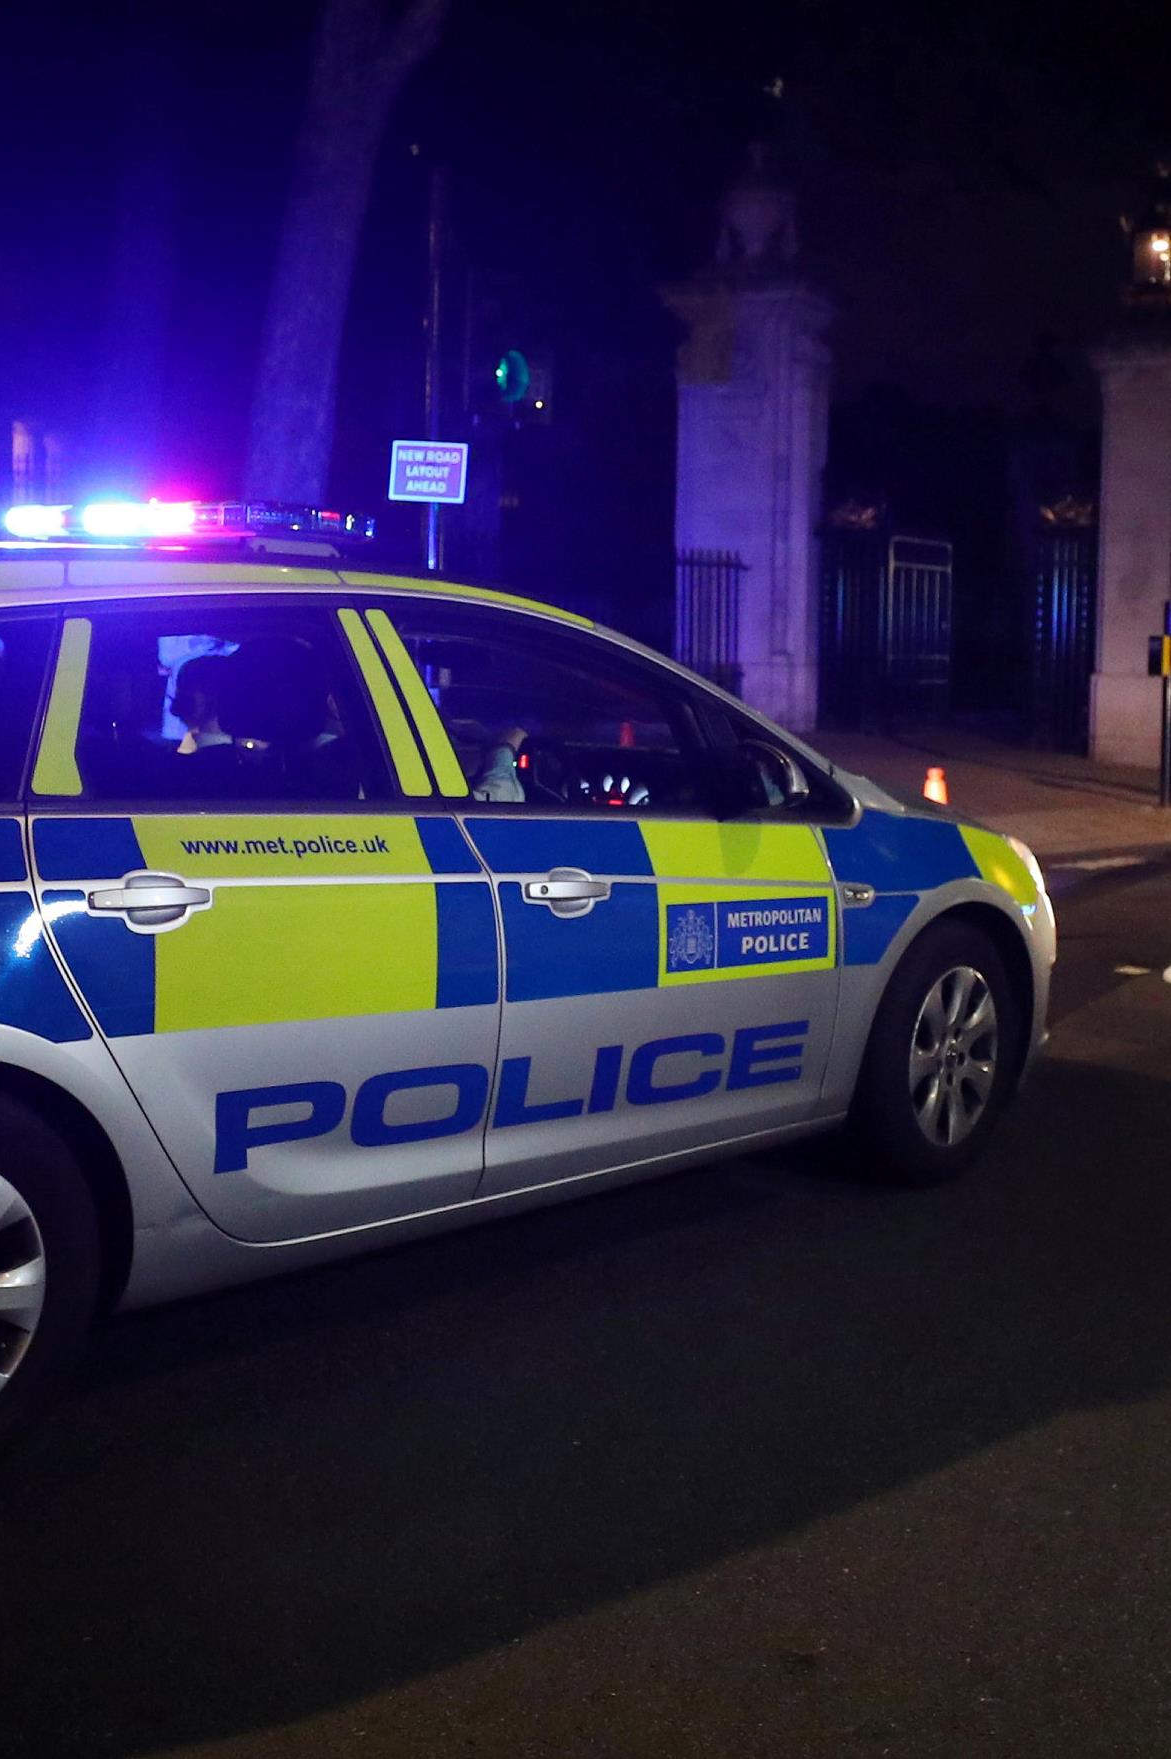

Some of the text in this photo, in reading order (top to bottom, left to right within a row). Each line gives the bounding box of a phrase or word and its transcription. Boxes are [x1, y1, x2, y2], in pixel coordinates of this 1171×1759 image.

[398, 450, 461, 464] NEW ROAD
[405, 465, 450, 479] LAYOUT
[405, 480, 447, 493] AHEAD
[180, 835, 390, 858] www.met.police.uk
[727, 908, 822, 928] METROPOLITAN
[741, 932, 809, 954] POLICE
[213, 1020, 810, 1174] POLICE
